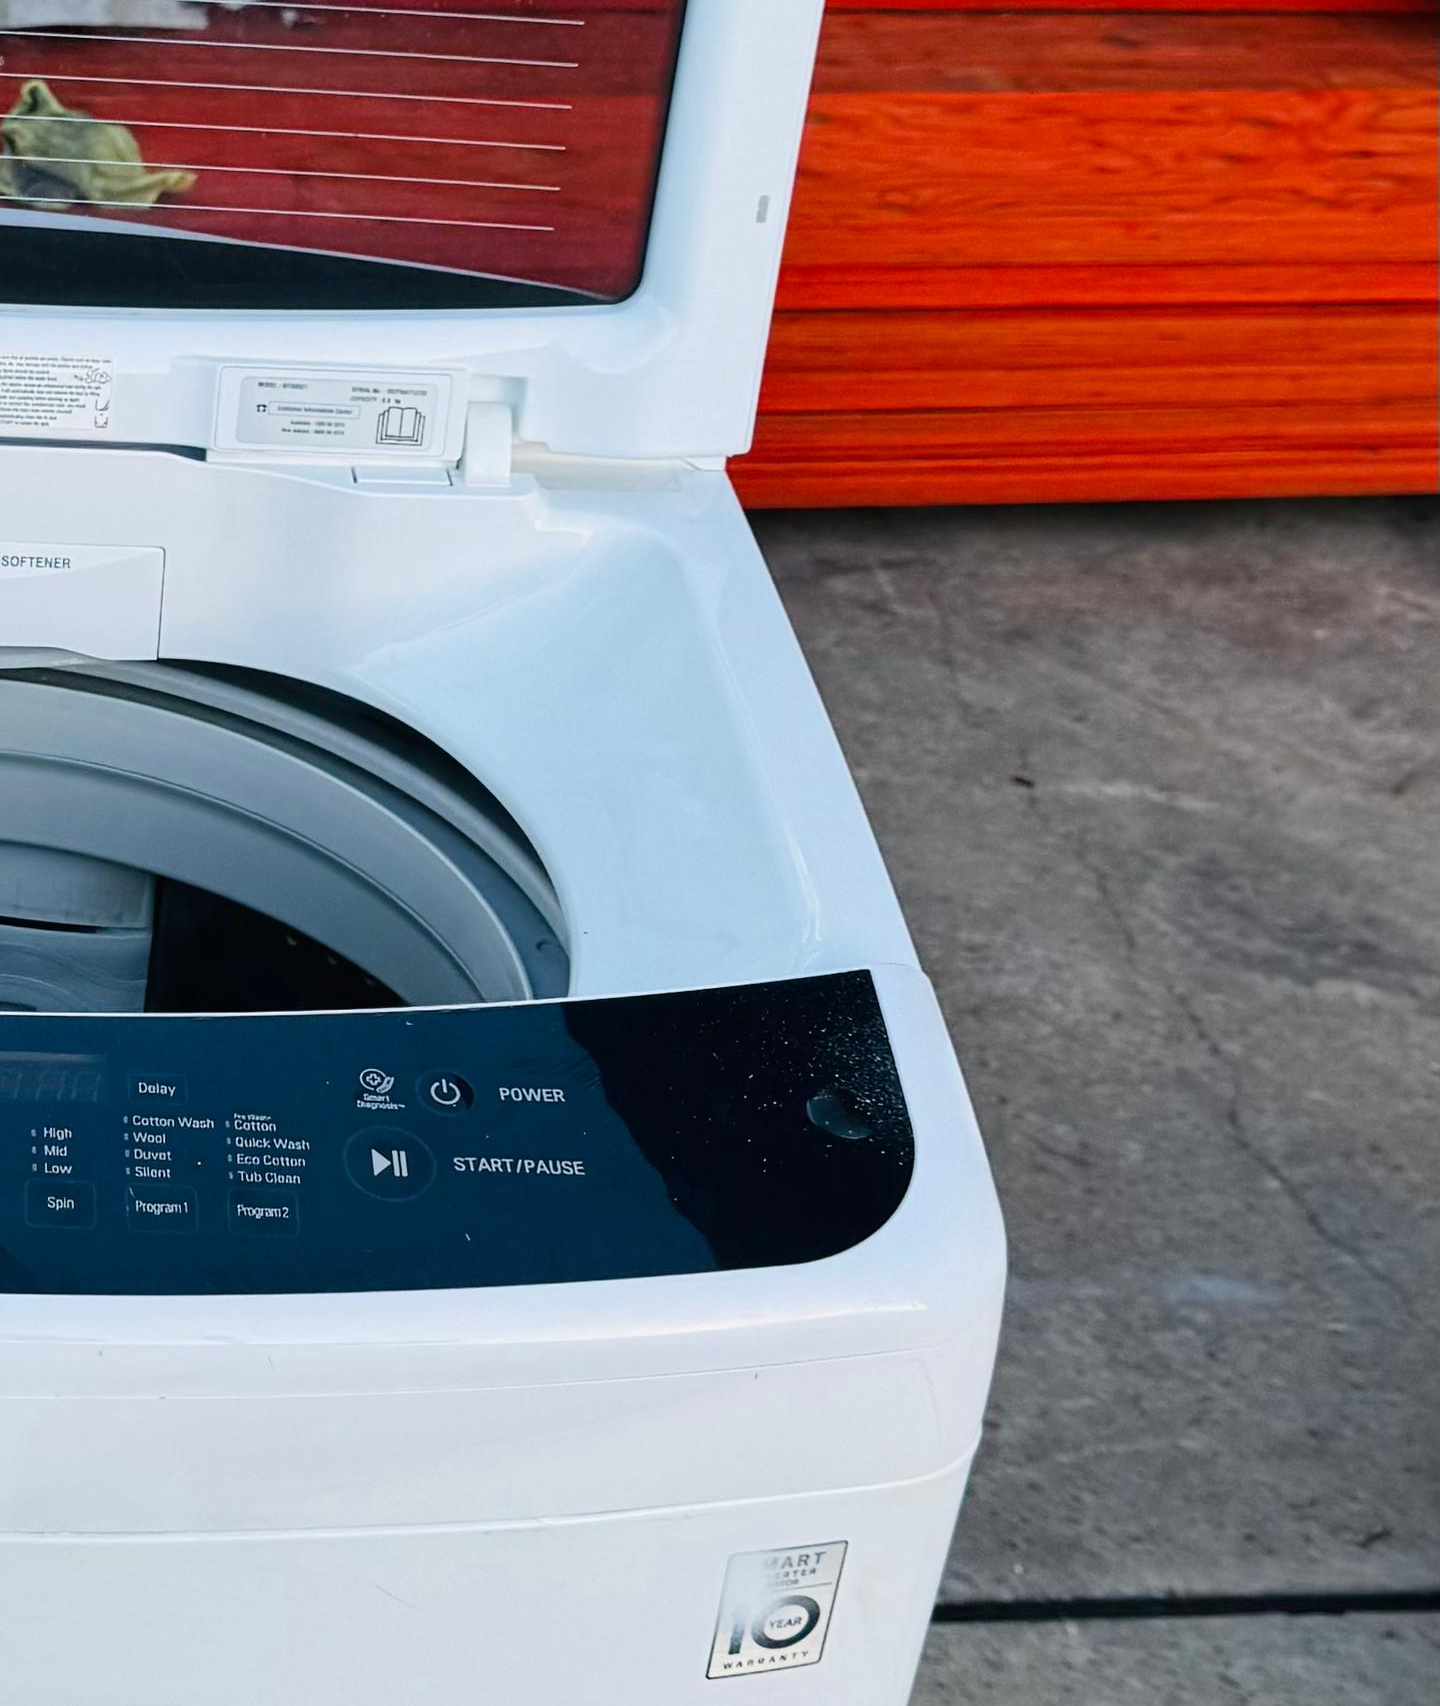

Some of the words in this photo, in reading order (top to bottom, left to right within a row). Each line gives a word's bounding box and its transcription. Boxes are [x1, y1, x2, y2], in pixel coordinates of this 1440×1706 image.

[1, 555, 71, 569] SOFTENER
[138, 1081, 177, 1098] Delay
[498, 1086, 566, 1103] POWER
[132, 1115, 175, 1128] Cotton
[177, 1116, 215, 1129] Wash
[234, 1119, 277, 1133] Cotton
[43, 1126, 73, 1141] High
[132, 1132, 167, 1144] Wool
[44, 1144, 68, 1157] Mid
[235, 1136, 271, 1149] Quick
[272, 1138, 311, 1151] Wash
[133, 1148, 172, 1162] Duvet
[236, 1153, 261, 1166] Eco
[263, 1155, 306, 1168] Cotton
[44, 1162, 73, 1175] Low
[134, 1166, 172, 1179] Silent
[452, 1156, 587, 1176] START/PAUSE
[237, 1170, 263, 1183] Tub
[264, 1171, 302, 1185] Clean
[47, 1195, 76, 1211] Spin
[135, 1199, 182, 1216] Program
[236, 1203, 282, 1220] Program
[728, 1595, 821, 1655] 10
[768, 1616, 803, 1630] YEAR
[722, 1650, 809, 1670] WARRANTY
